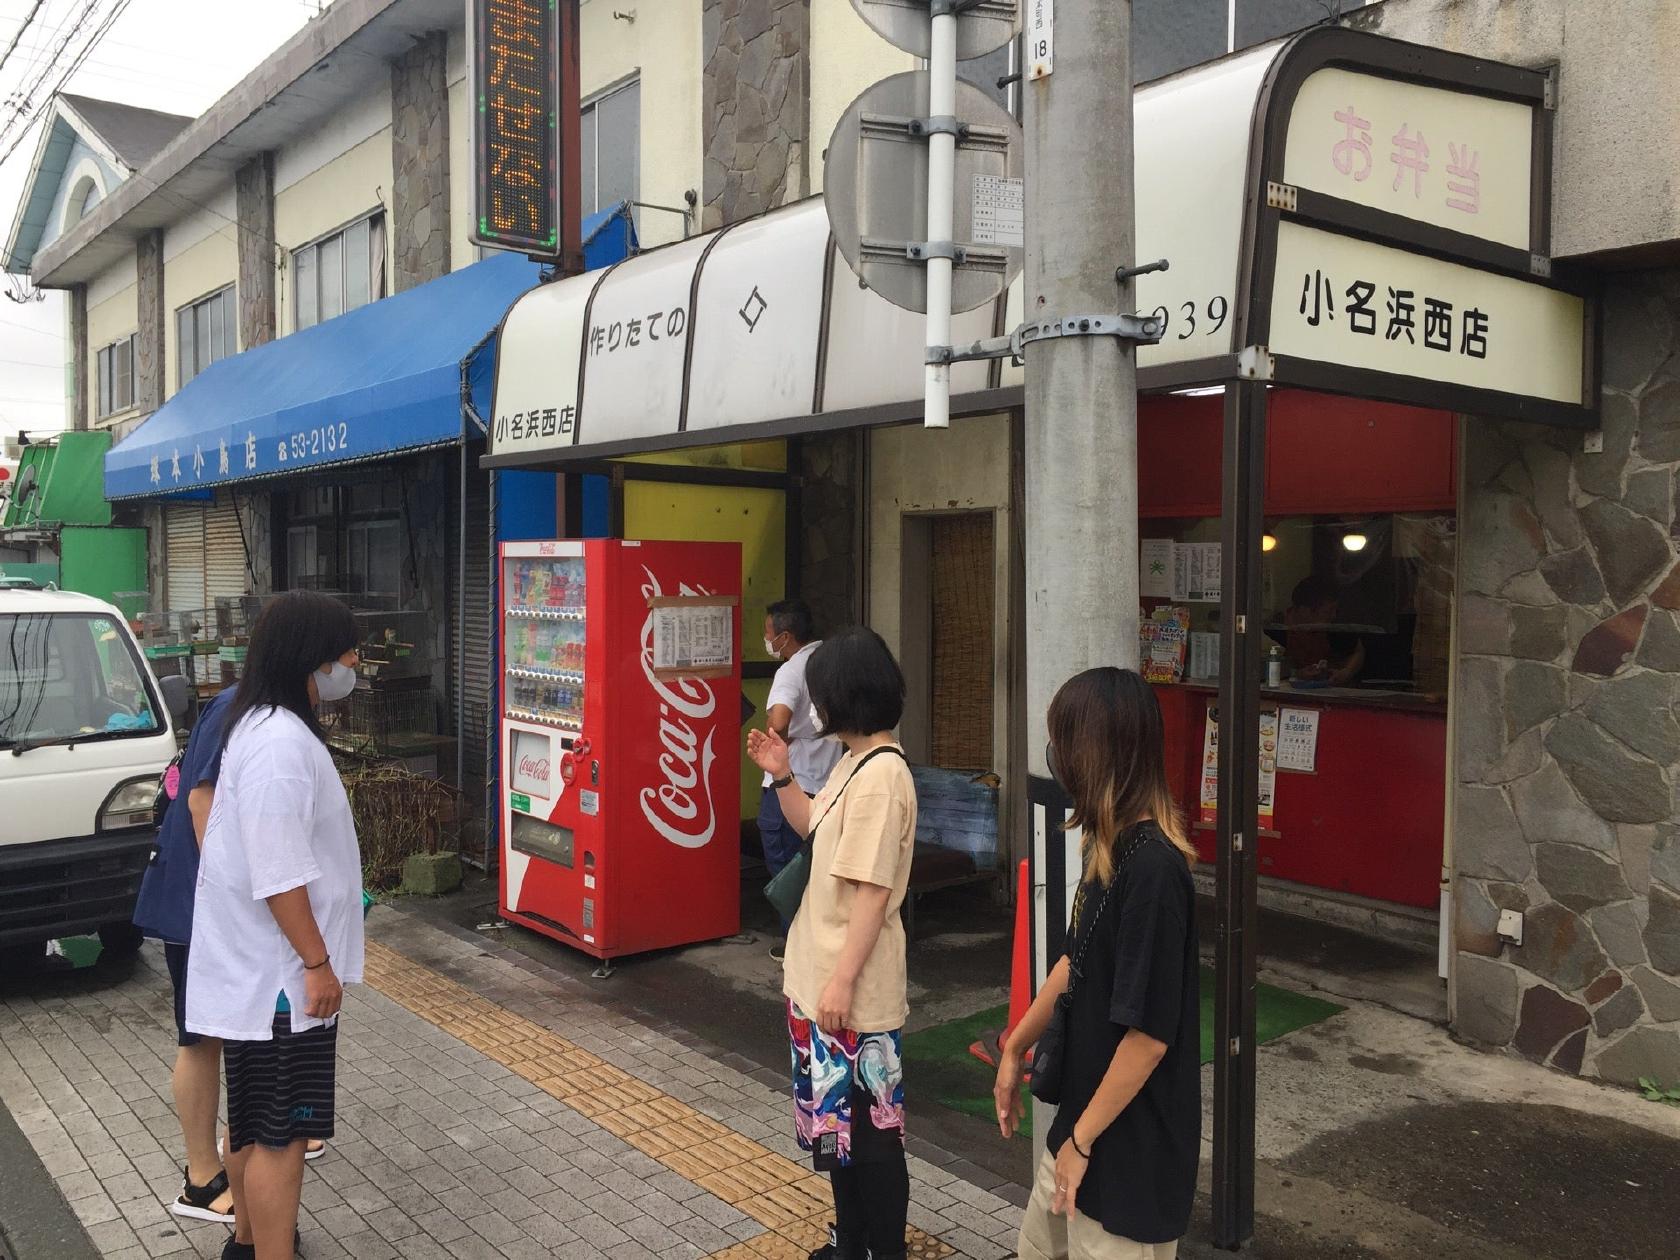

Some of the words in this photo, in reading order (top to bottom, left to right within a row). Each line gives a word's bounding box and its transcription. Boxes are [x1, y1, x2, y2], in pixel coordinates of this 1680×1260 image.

[1034, 40, 1047, 59] 18
[1331, 105, 1482, 214] お弁当
[589, 307, 686, 357] 作りたての
[1299, 269, 1489, 359] 小名浜西店
[290, 422, 348, 459] 53-2132
[495, 405, 575, 443] 小名浜西店
